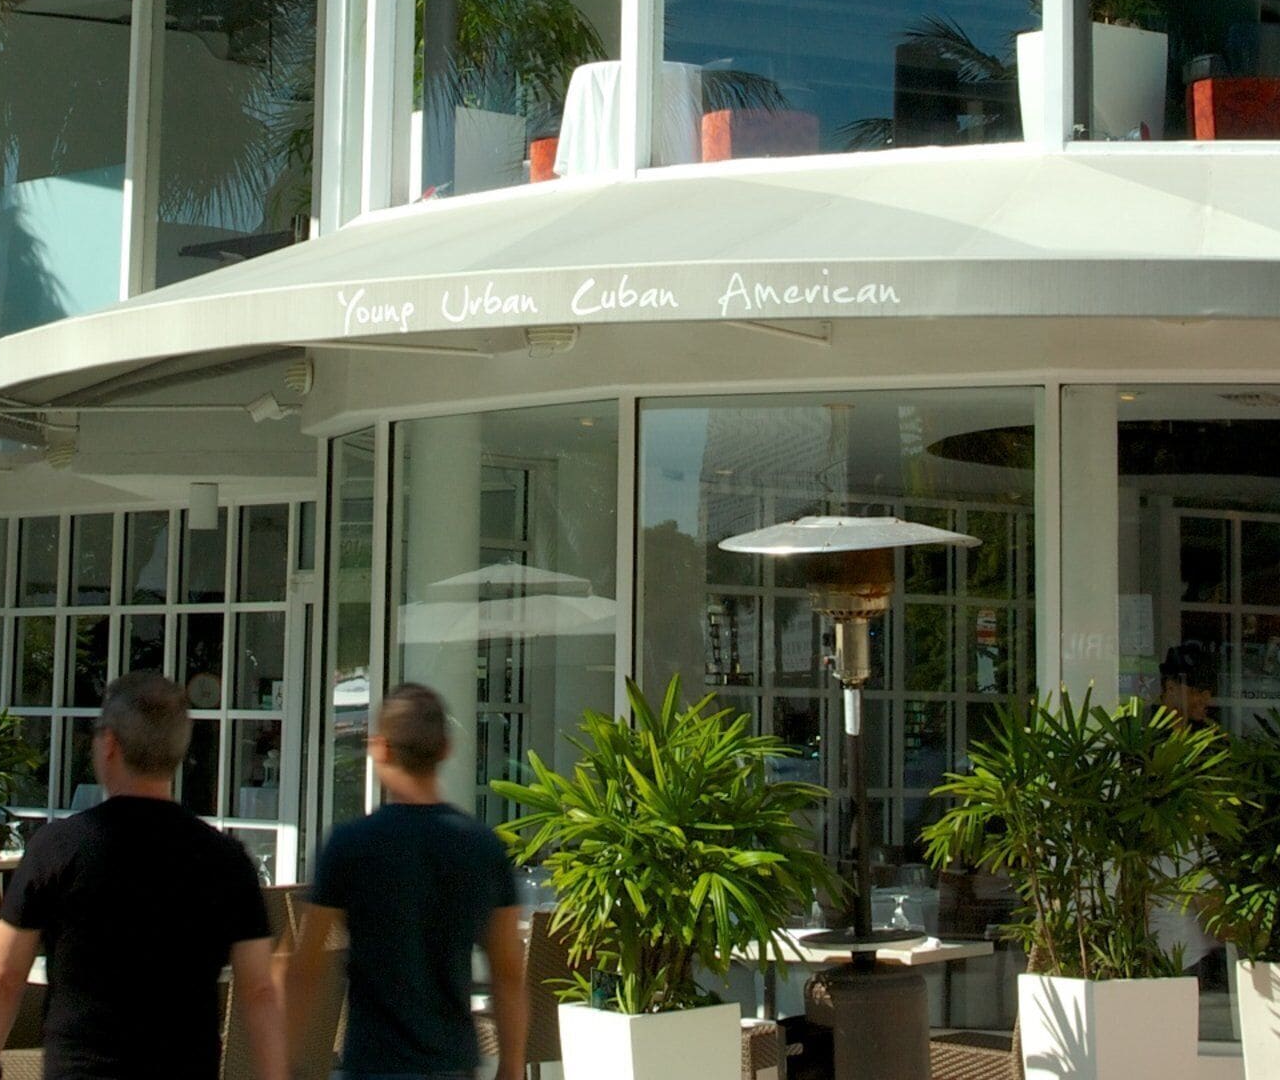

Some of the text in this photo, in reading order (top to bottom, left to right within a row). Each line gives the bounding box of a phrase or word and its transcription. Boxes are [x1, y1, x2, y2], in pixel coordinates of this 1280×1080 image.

[337, 269, 901, 335] Young Urban Cuban American
